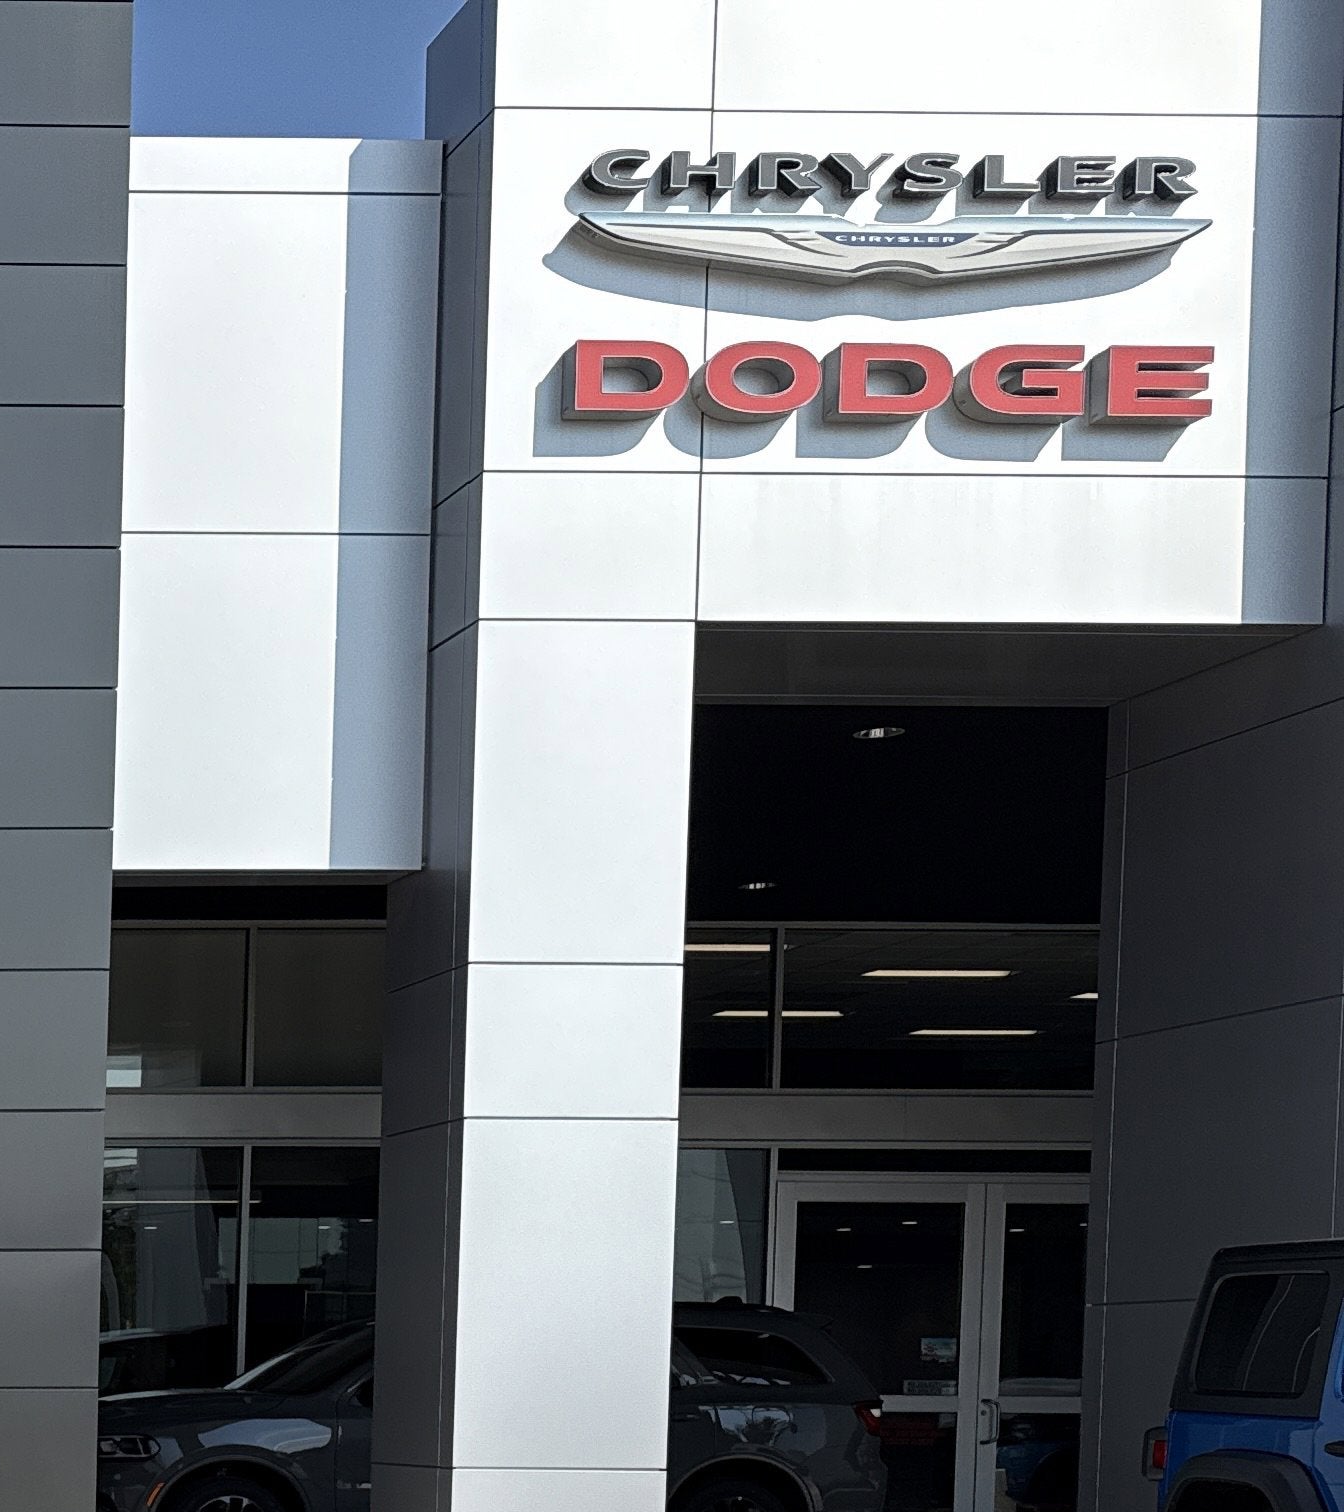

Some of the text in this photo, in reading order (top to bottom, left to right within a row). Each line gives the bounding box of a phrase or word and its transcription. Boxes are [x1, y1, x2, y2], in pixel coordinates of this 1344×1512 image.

[584, 149, 1198, 199] CHRYSLER
[834, 235, 955, 243] CHRYSLER
[564, 340, 1216, 424] DODGE
